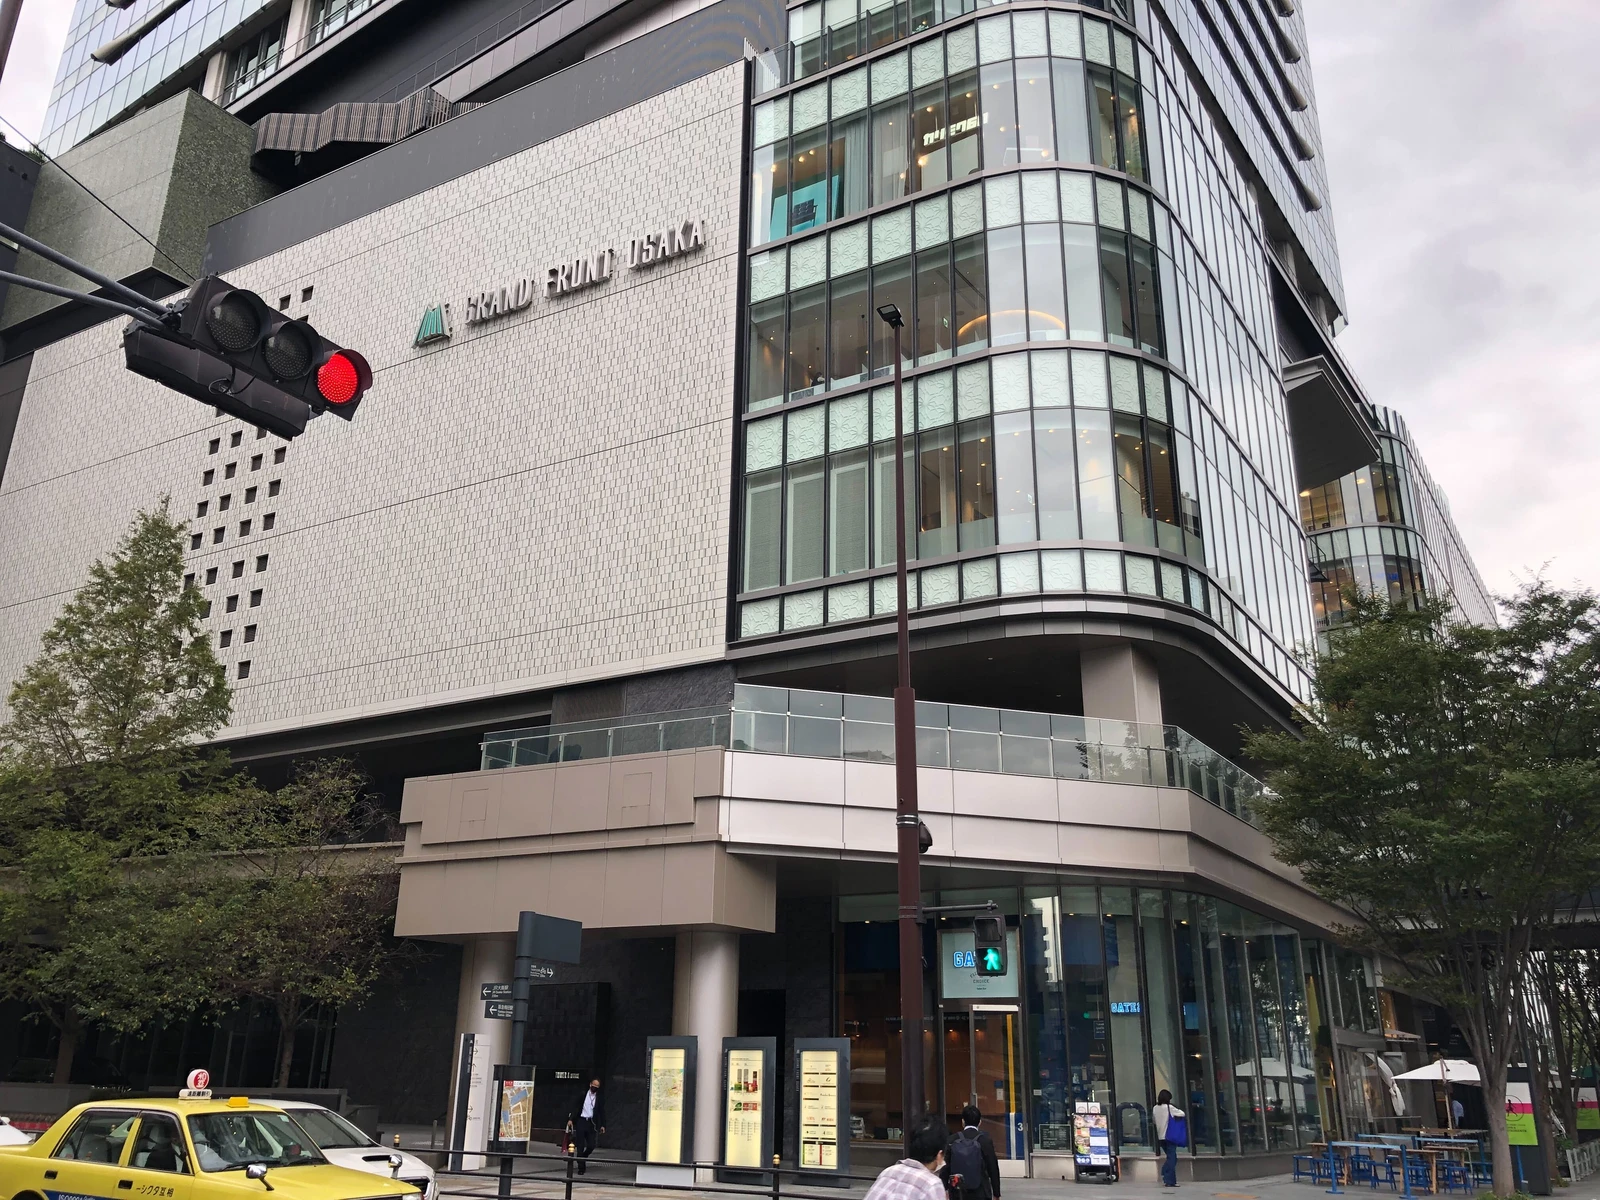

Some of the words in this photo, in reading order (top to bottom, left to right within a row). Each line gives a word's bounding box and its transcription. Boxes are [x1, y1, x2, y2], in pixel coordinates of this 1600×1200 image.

[465, 275, 535, 326] GRAND
[544, 248, 614, 299] FRONT
[626, 214, 706, 270] OSAKA
[953, 950, 977, 969] GA
